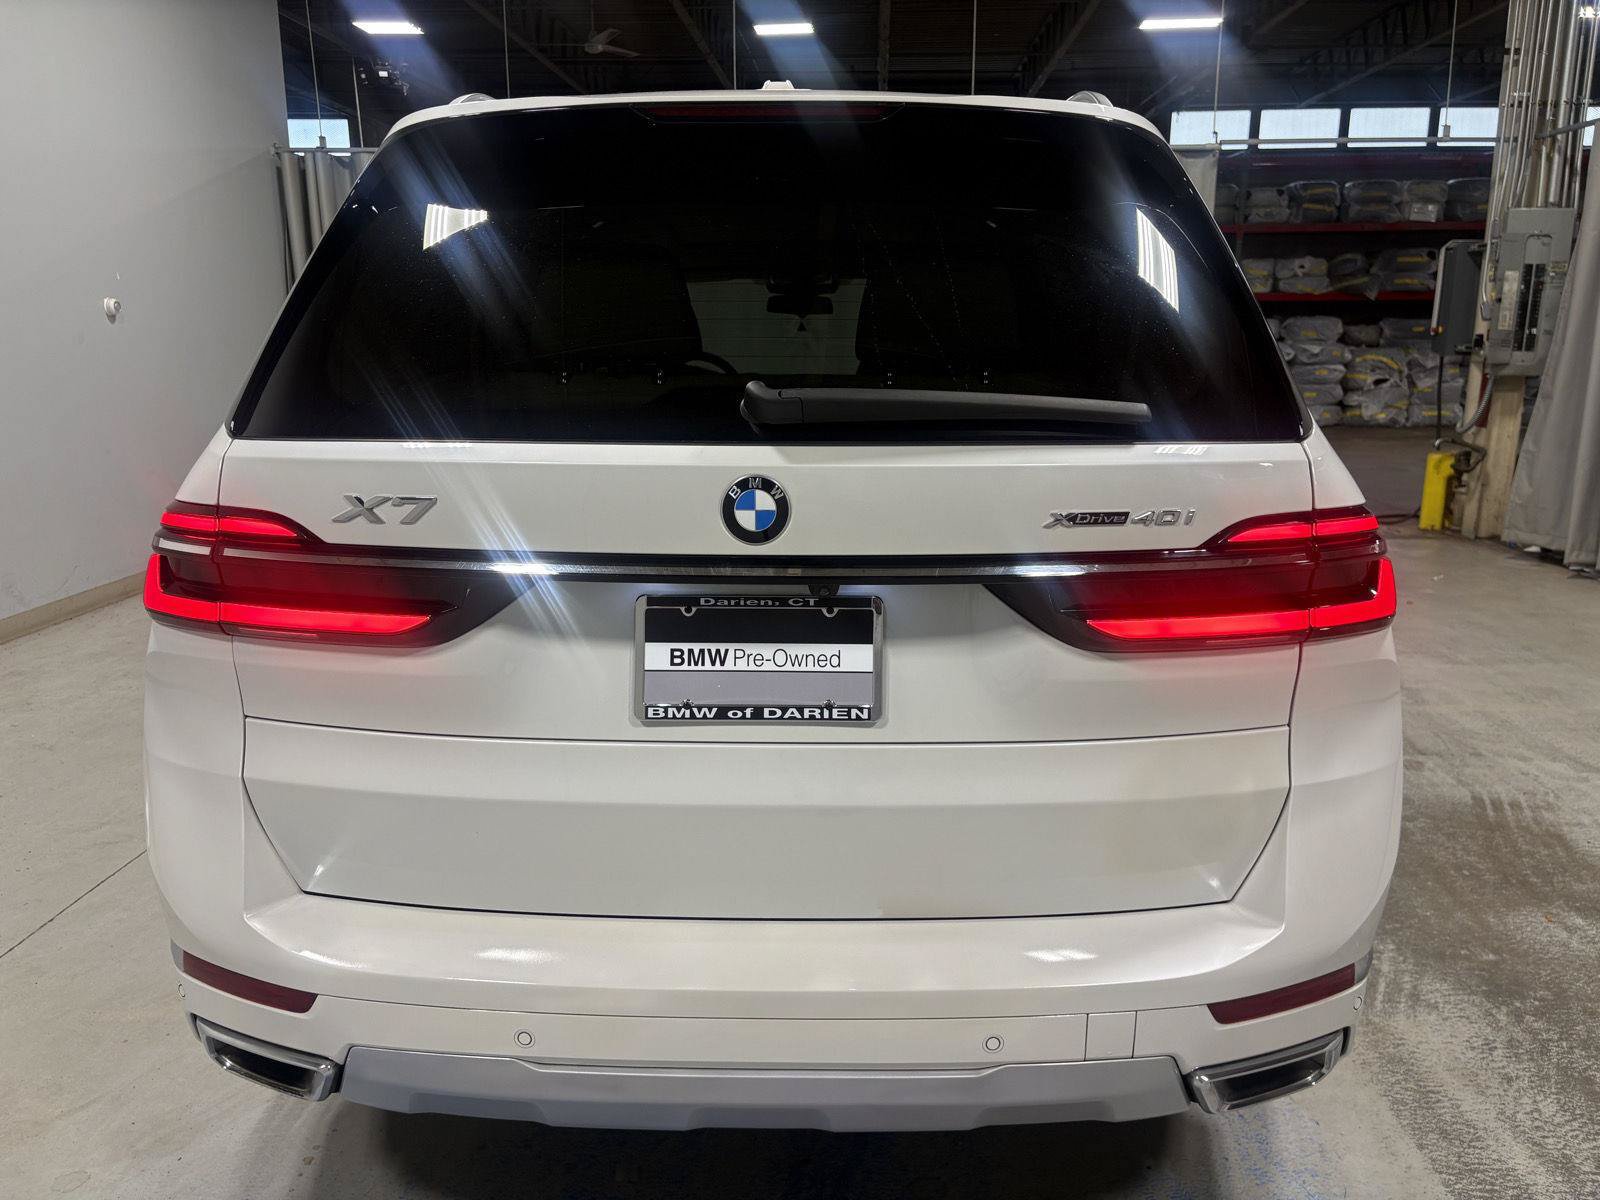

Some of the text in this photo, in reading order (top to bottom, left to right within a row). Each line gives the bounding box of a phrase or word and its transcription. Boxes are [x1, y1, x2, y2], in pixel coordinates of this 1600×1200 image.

[728, 477, 784, 500] BMW
[331, 494, 438, 526] X7
[700, 597, 820, 607] Darien, CT
[669, 648, 842, 668] BMW Pre-Owned
[647, 707, 870, 720] BMW of DARIEN
